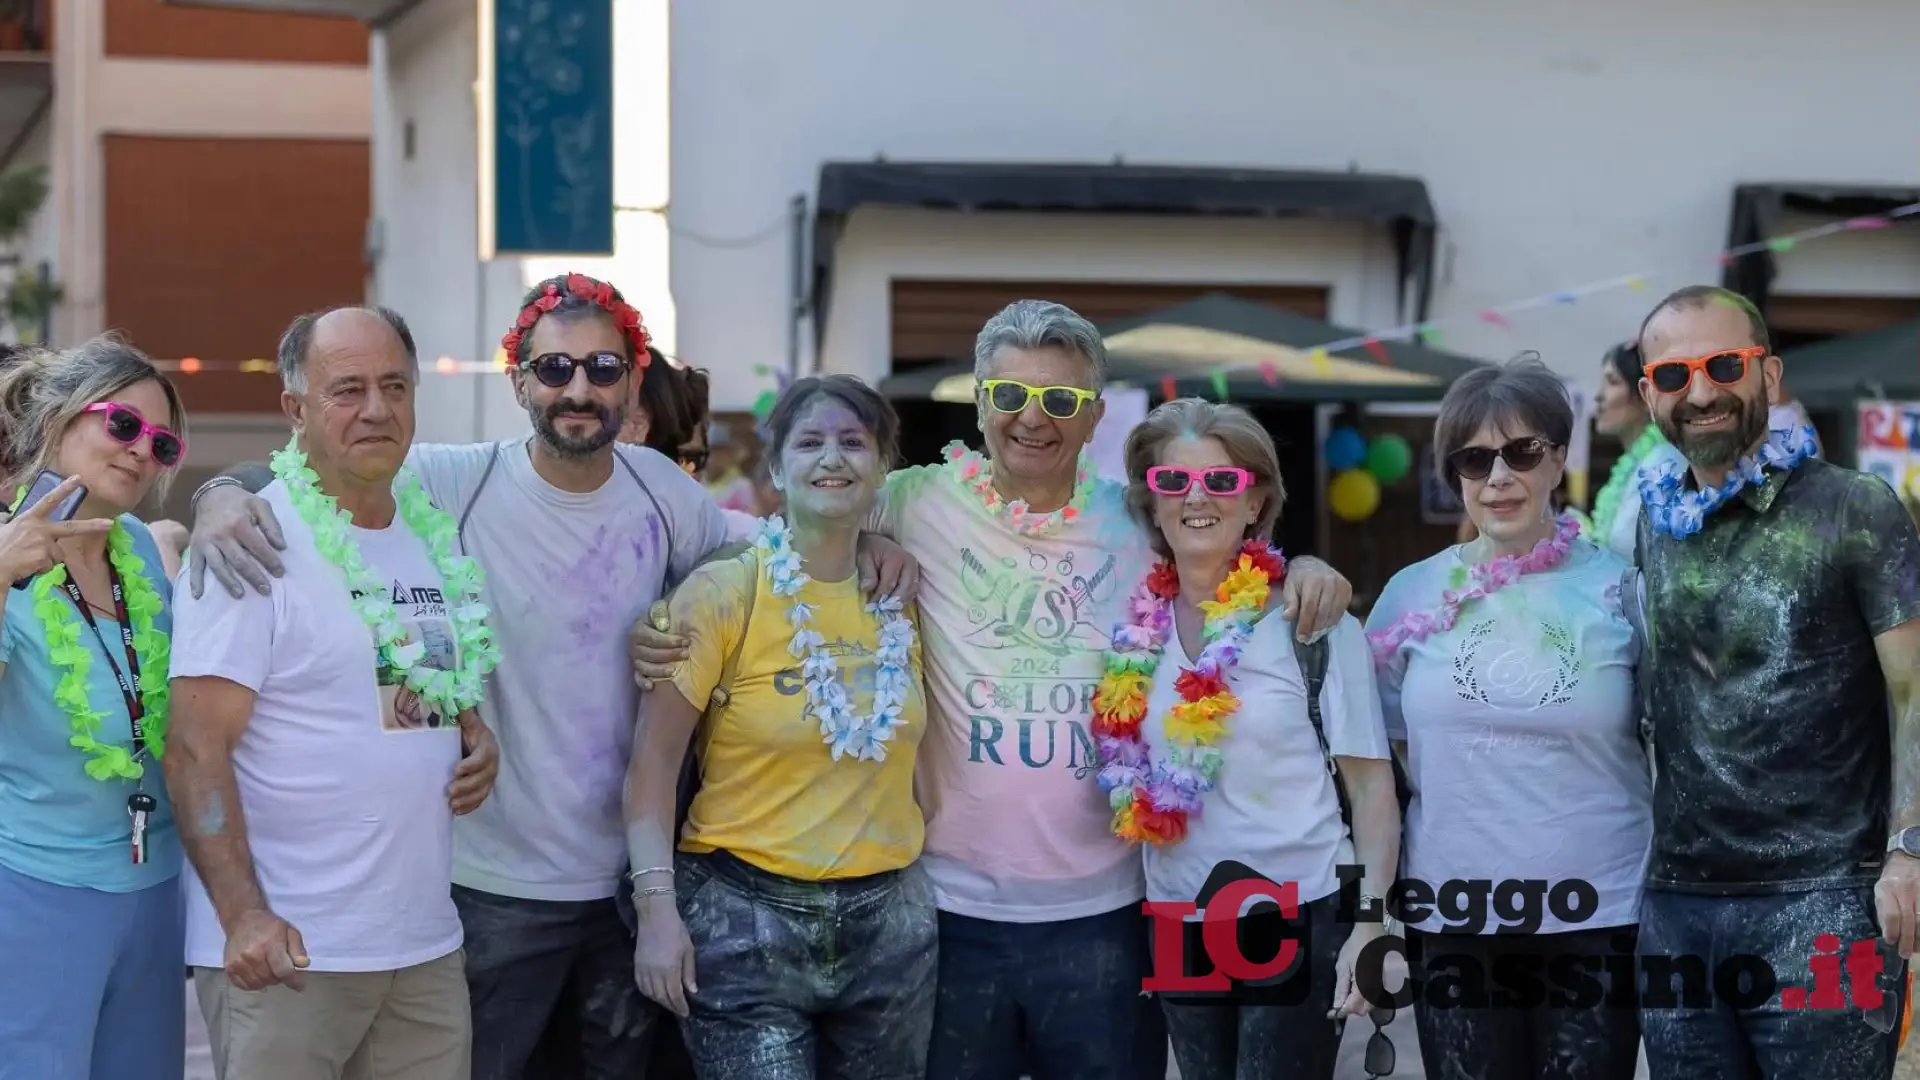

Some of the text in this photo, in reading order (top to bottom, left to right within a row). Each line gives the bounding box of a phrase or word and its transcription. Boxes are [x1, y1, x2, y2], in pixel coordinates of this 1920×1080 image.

[67, 584, 80, 601] Alfa
[113, 584, 121, 601] Alfa
[1011, 658, 1060, 675] 2024
